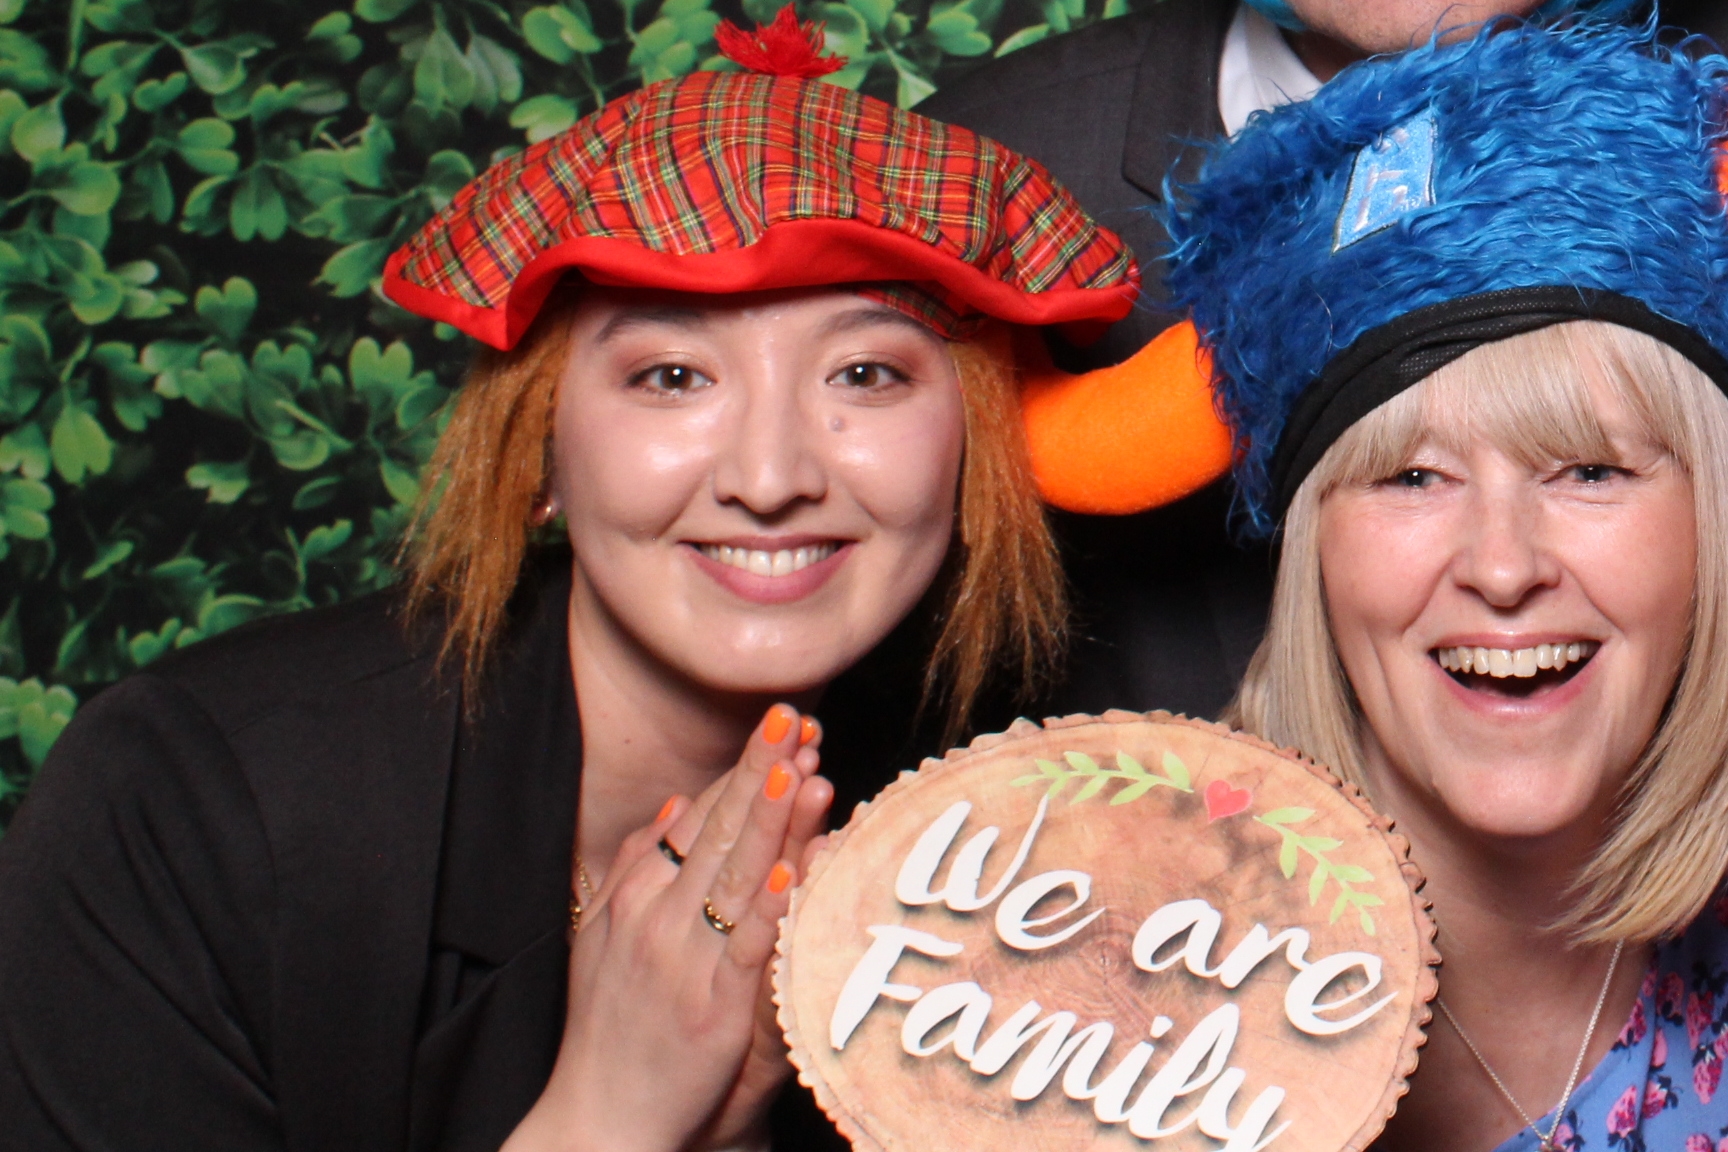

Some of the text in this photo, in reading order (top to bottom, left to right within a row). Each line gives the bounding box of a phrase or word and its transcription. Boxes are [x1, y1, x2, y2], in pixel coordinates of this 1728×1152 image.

[895, 794, 1399, 1035] We are
[829, 925, 1293, 1152] Family
